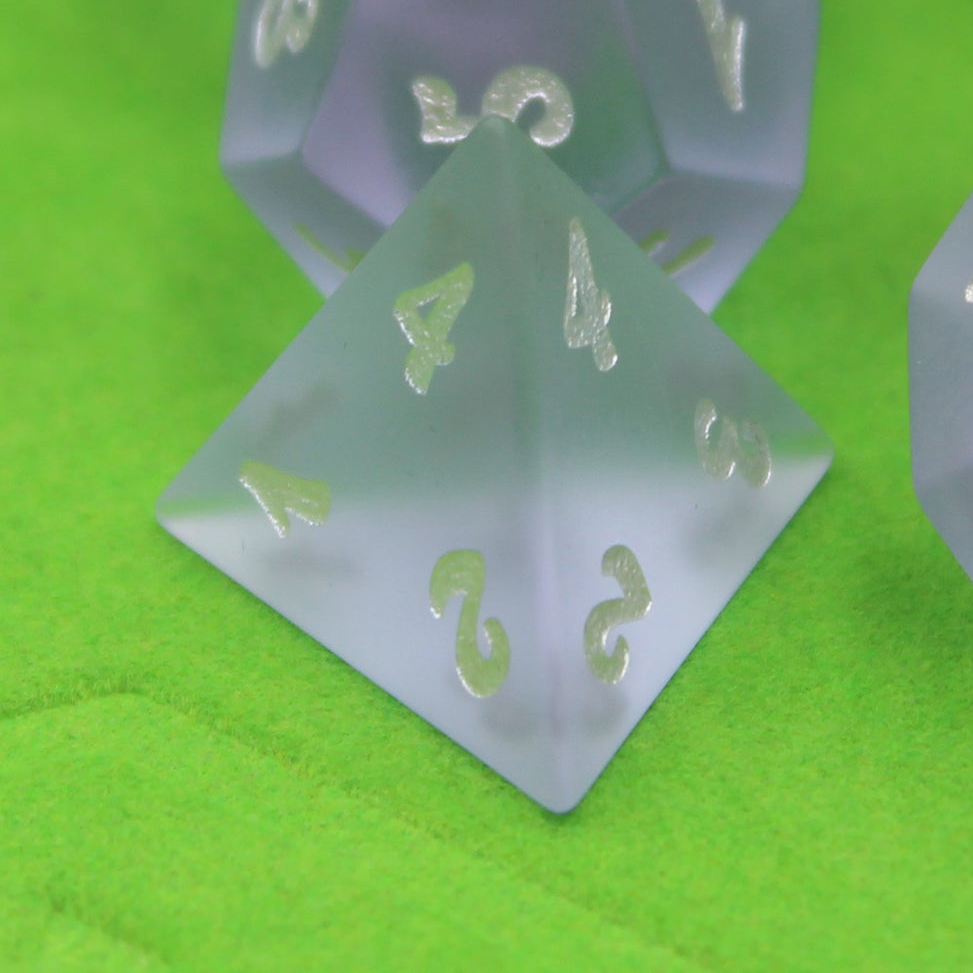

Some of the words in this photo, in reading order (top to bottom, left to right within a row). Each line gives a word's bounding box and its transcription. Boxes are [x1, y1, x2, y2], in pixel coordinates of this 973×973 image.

[394, 262, 476, 395] 4
[563, 217, 619, 372] 4
[429, 549, 511, 699] 2
[584, 544, 653, 686] 2
